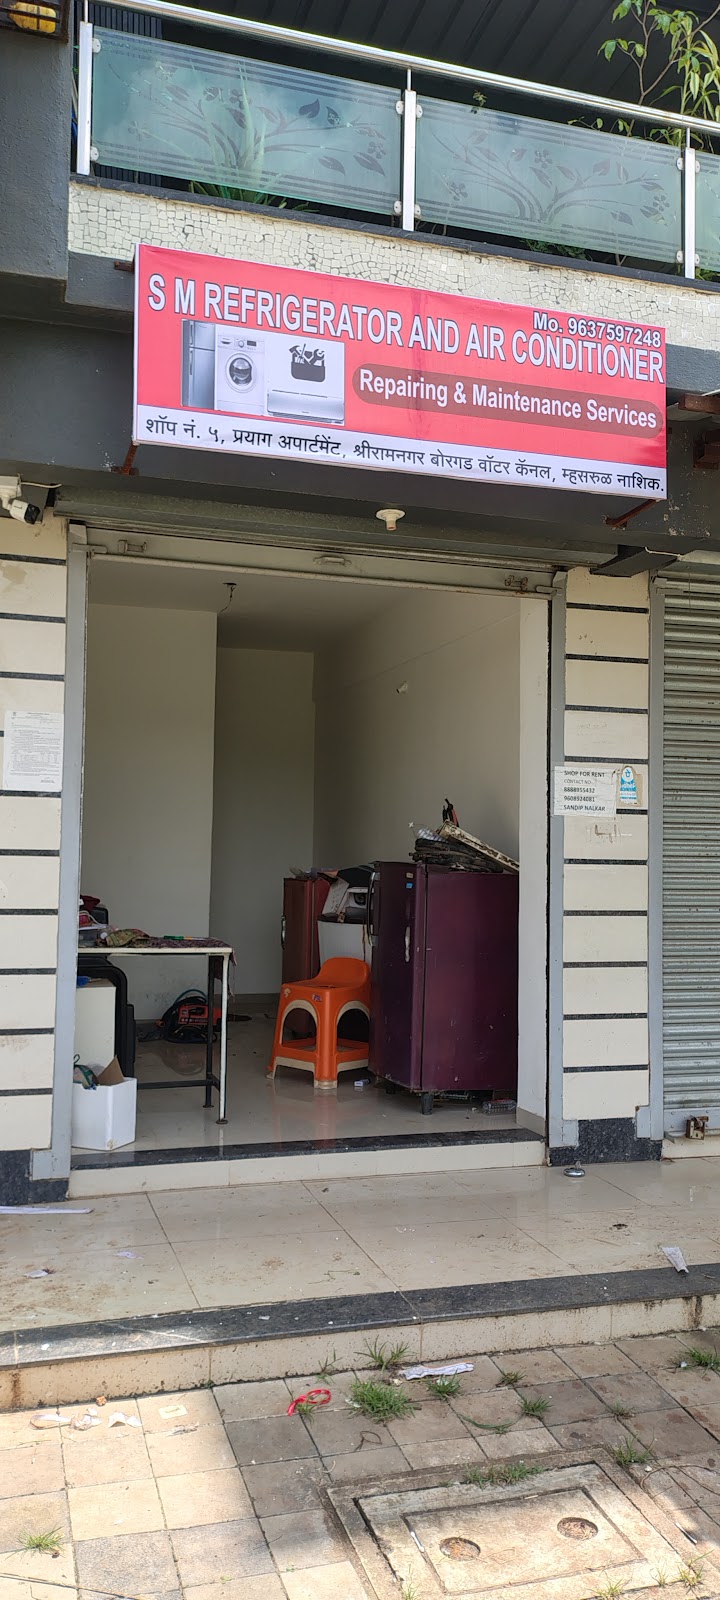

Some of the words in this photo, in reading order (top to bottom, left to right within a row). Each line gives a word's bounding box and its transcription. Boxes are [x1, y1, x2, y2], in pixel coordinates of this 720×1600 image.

[148, 273, 166, 311] S
[174, 277, 196, 316] M
[204, 281, 404, 347] REFRIGERATOR
[408, 315, 460, 354] AND
[465, 323, 506, 361] AIR
[511, 329, 665, 384] CONDITIONER
[533, 311, 563, 333] Mo.
[567, 316, 661, 348] 9637597248
[359, 368, 448, 407] Repairing
[453, 381, 467, 405] &
[472, 384, 582, 419] Maintenance
[587, 399, 657, 429] Services
[145, 415, 178, 436] शॉप
[183, 419, 201, 439] नं.
[208, 426, 225, 445] ५,
[232, 429, 273, 447] प्रयाग
[278, 434, 346, 458] अपार्टमेंट,
[353, 439, 425, 465] श्रीरामनगर
[430, 449, 473, 470] बोरगड
[478, 455, 510, 475] वॉटर
[515, 459, 556, 483] कॅनल,
[562, 468, 613, 485] म्हसरुळ
[617, 472, 664, 491] नाशिक.
